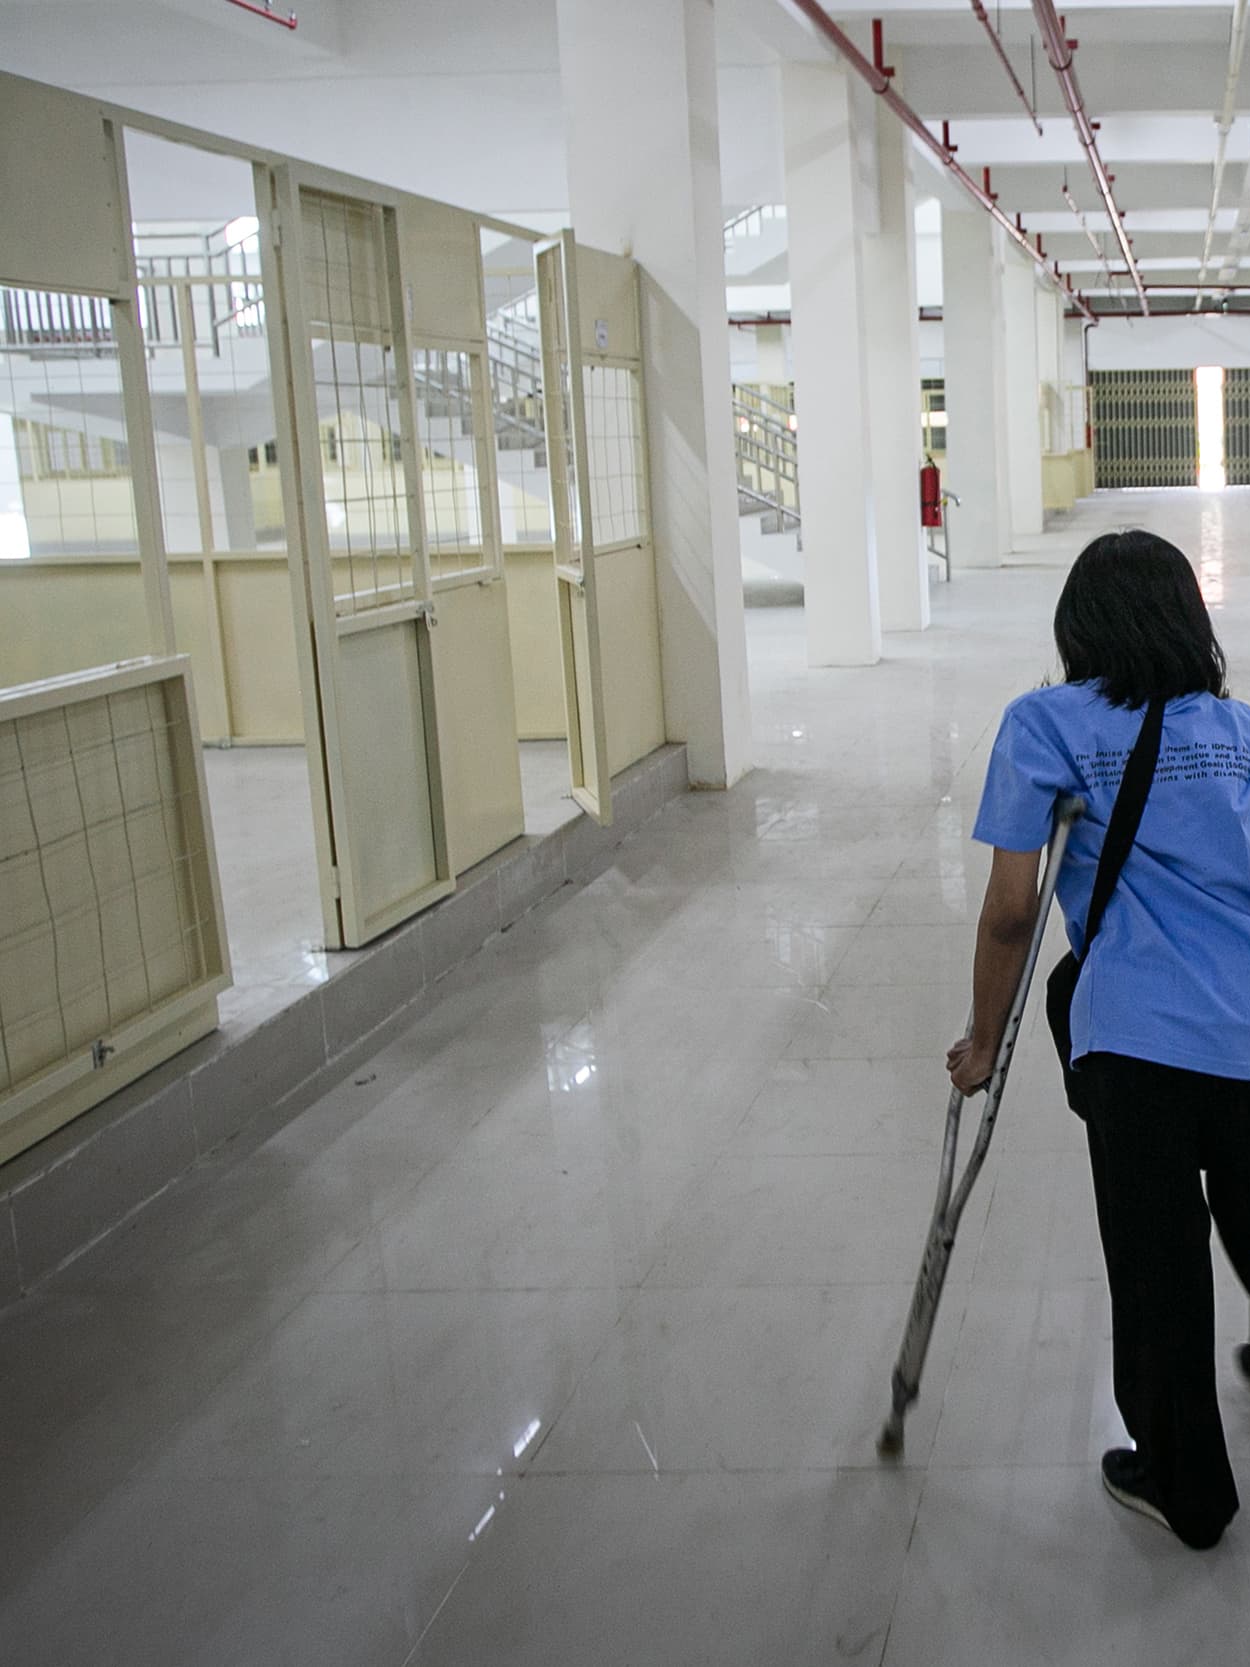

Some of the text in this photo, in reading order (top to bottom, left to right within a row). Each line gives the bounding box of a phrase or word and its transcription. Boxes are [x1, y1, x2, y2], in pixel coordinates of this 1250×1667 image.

[1194, 742, 1207, 750] for
[1182, 751, 1210, 762] rescue
[1214, 752, 1230, 760] and
[1200, 760, 1224, 769] Goals
[1184, 771, 1208, 780] with
